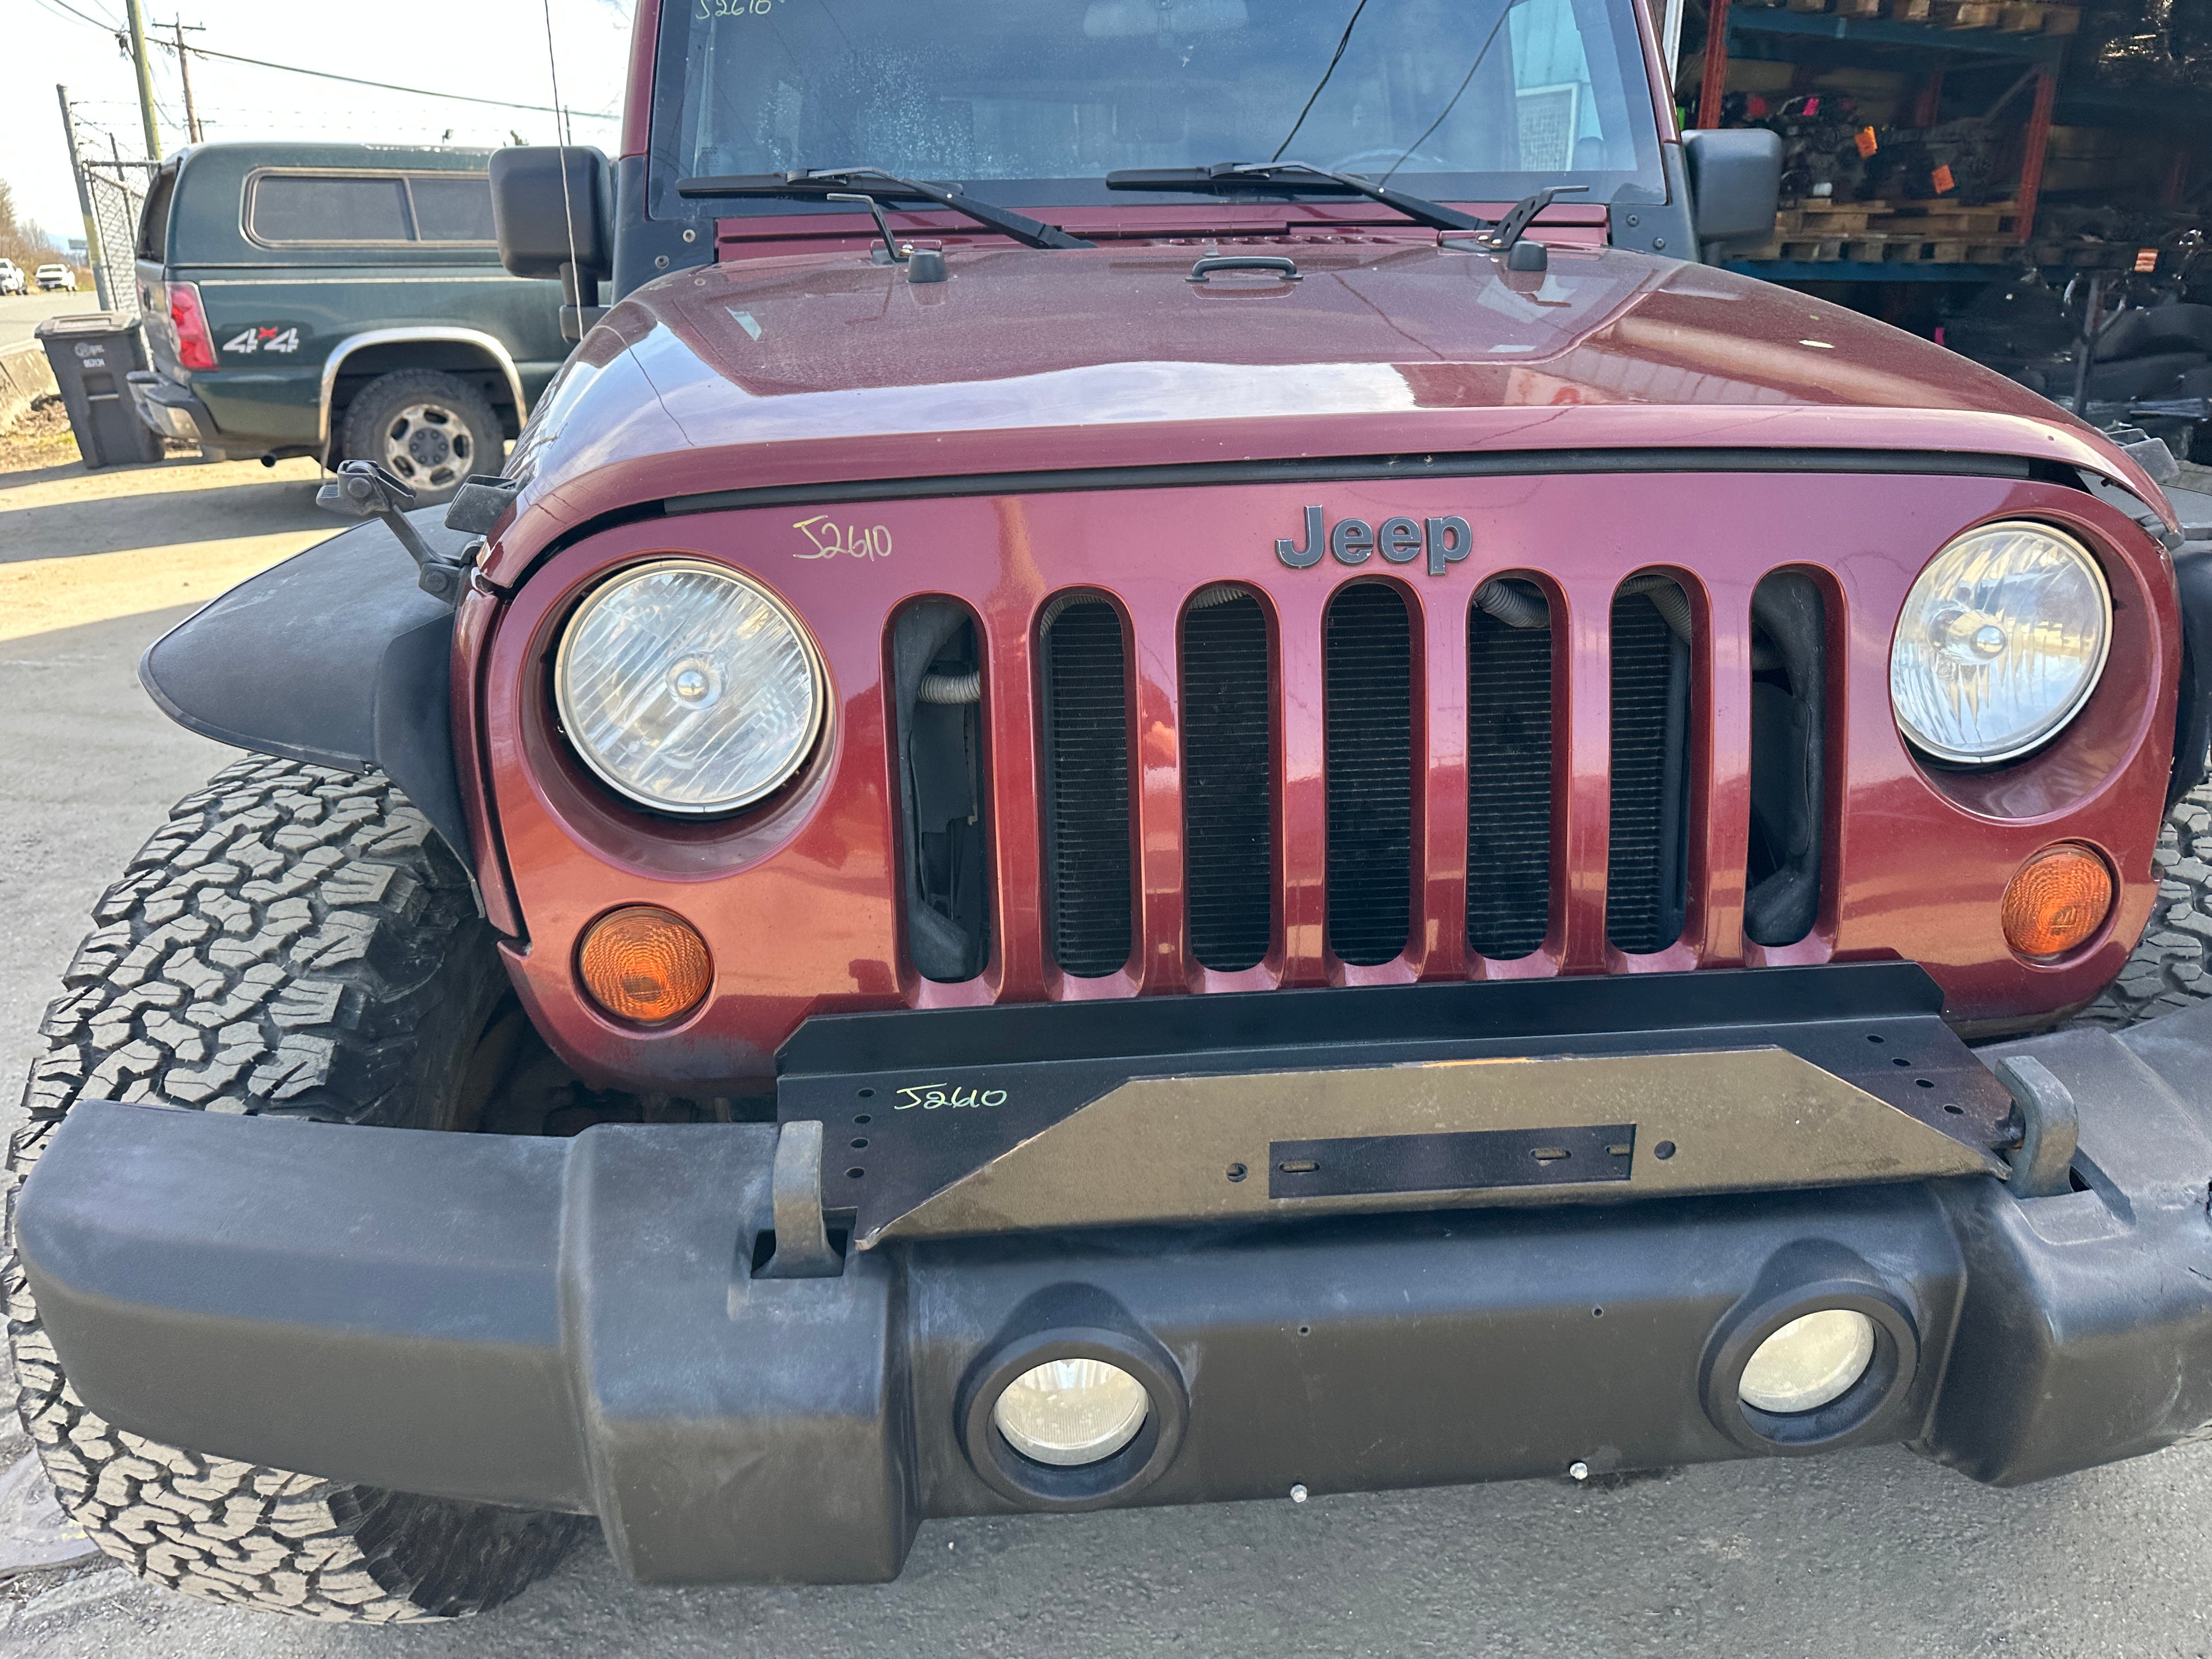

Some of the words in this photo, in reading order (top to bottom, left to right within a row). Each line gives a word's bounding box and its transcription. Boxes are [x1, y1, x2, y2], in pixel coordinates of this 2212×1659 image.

[695, 0, 772, 20] J2610
[793, 514, 892, 562] J2610
[1275, 505, 1472, 576] Jeep
[894, 1082, 1007, 1109] J2610
